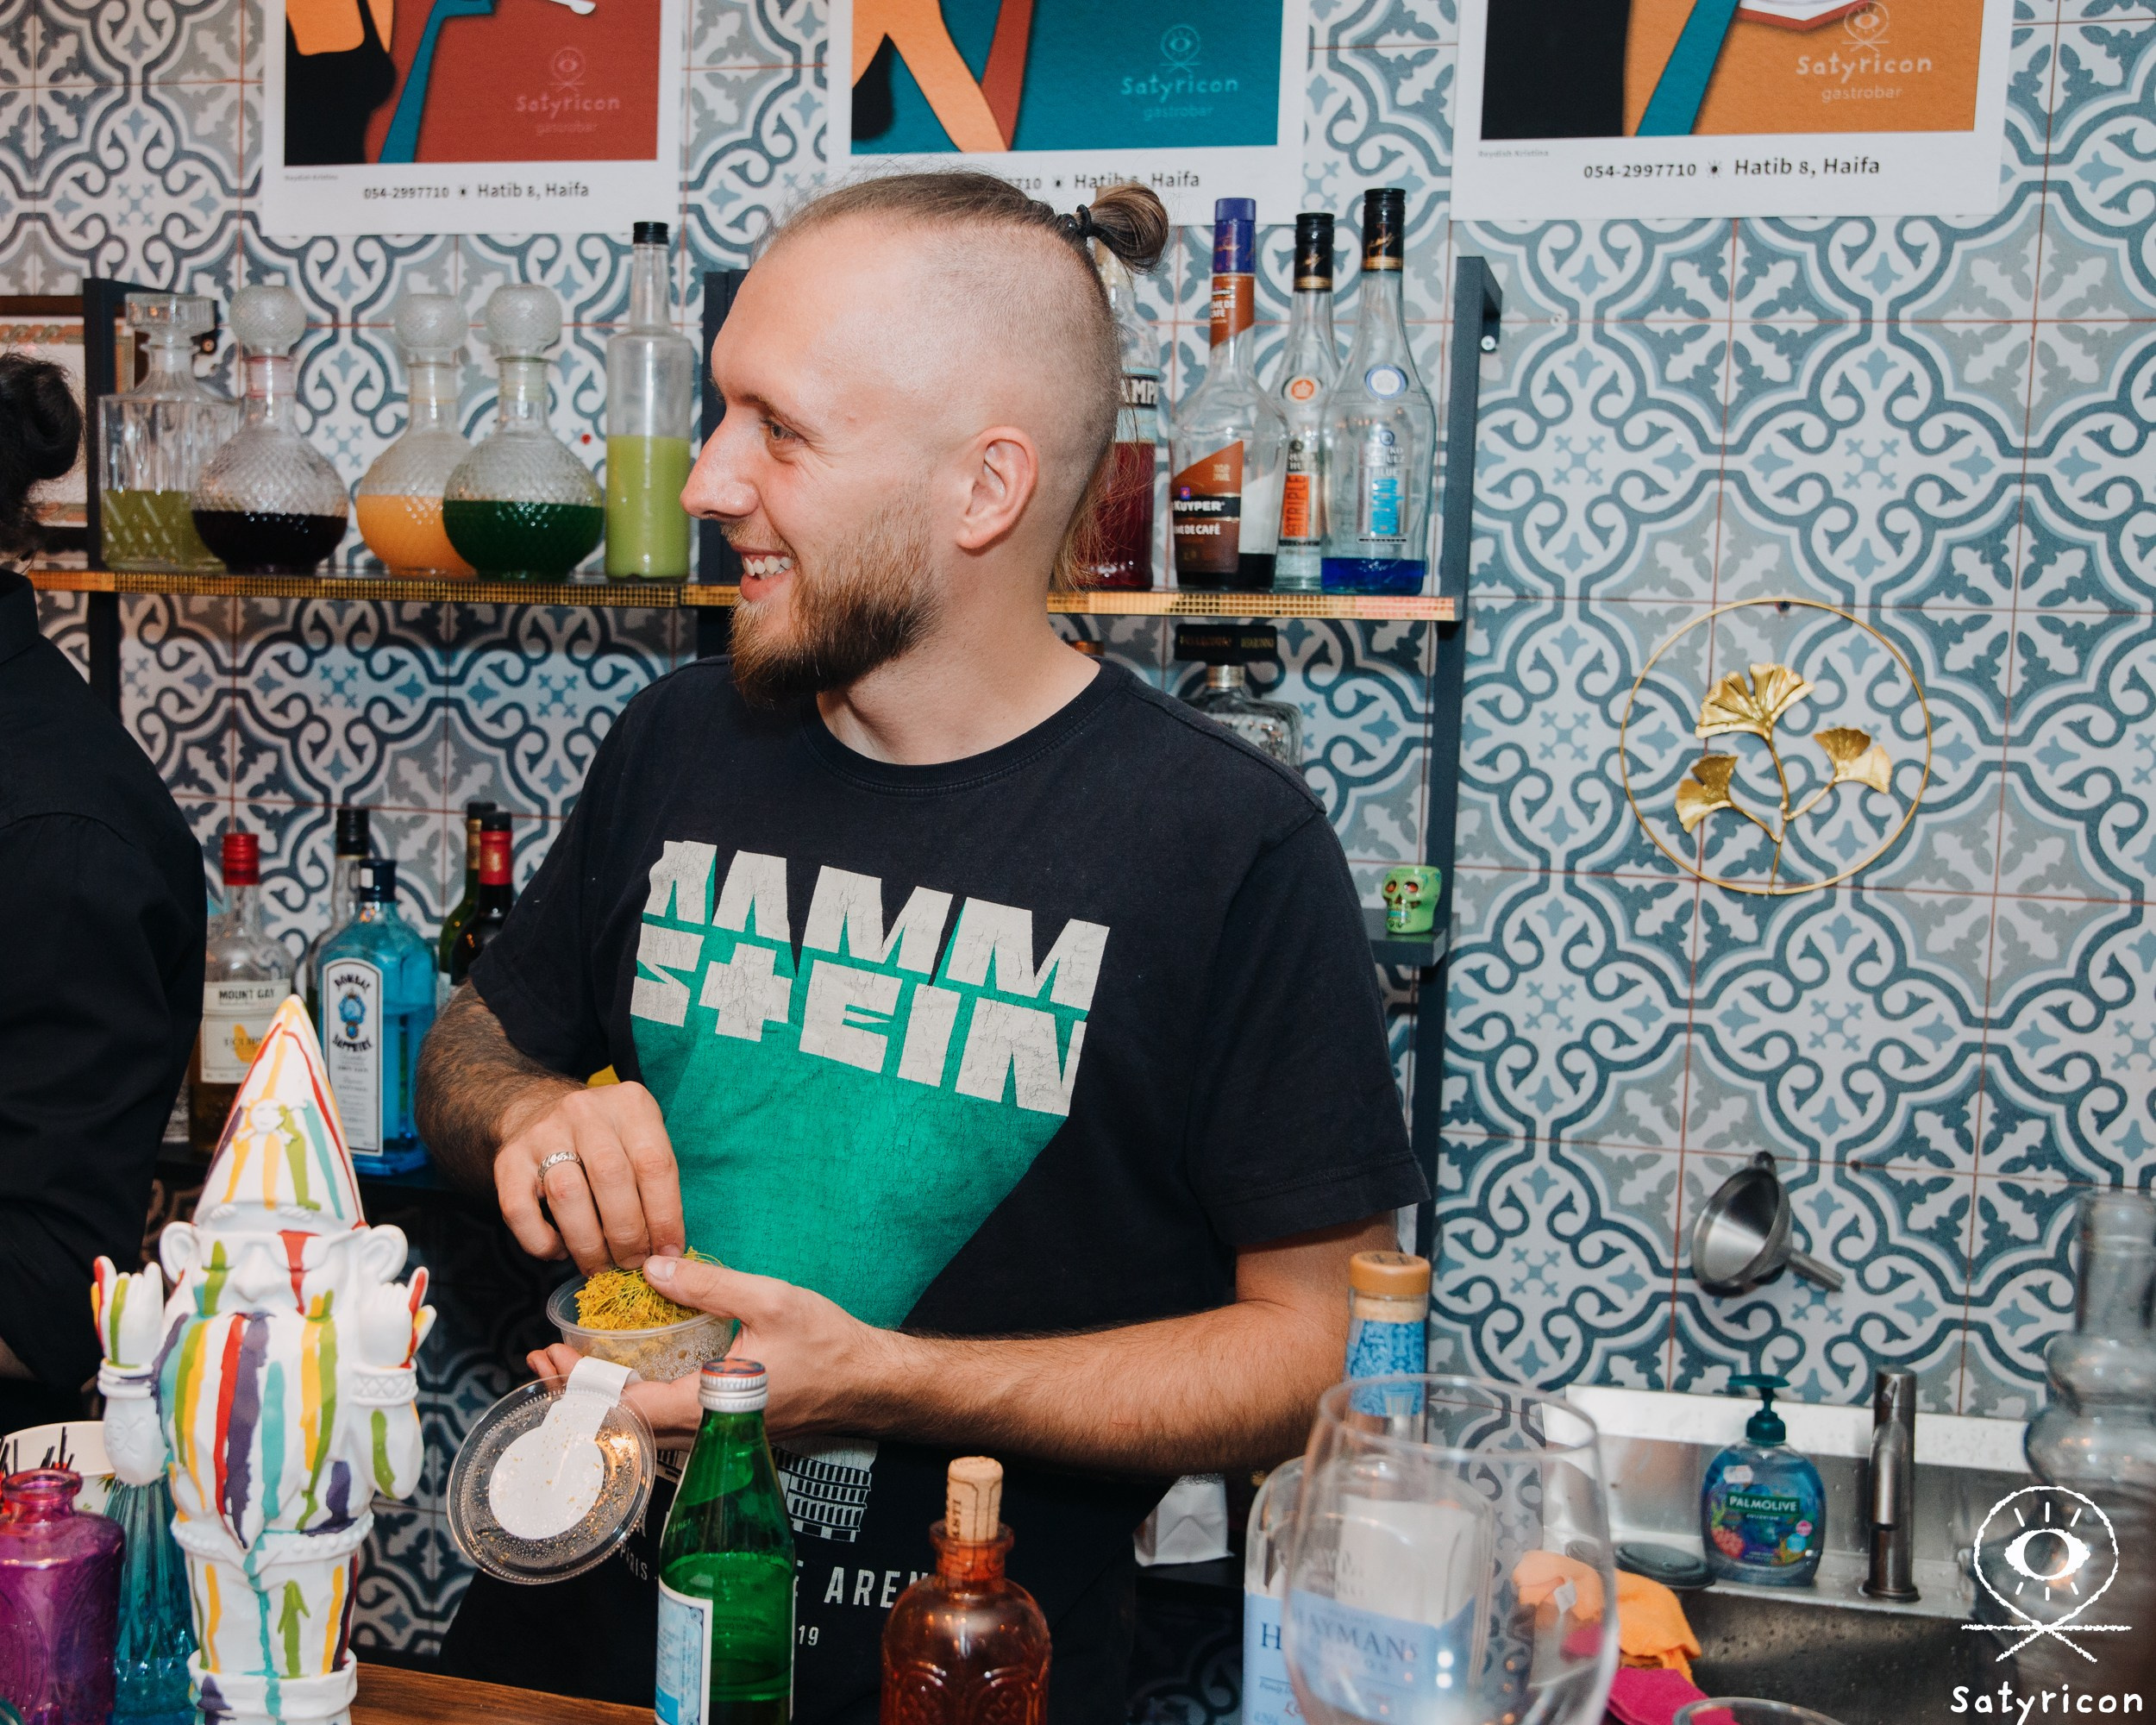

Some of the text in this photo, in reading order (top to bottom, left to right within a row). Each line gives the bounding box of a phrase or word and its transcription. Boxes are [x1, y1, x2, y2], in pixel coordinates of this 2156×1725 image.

[1796, 52, 1932, 84] Satyricon
[1121, 72, 1238, 103] Satyricon
[1821, 86, 1902, 103] gastrobar
[517, 92, 620, 119] Satyricon
[1583, 163, 1696, 178] 054-2997710
[1734, 158, 1792, 176] Hatib
[1823, 156, 1880, 175] Haifa
[1151, 172, 1199, 187] Haifa
[478, 184, 523, 198] Hatib
[546, 182, 589, 197] Haifa
[219, 988, 275, 1000] MOUNT GAY
[1729, 1496, 1796, 1511] PALMOLIVE
